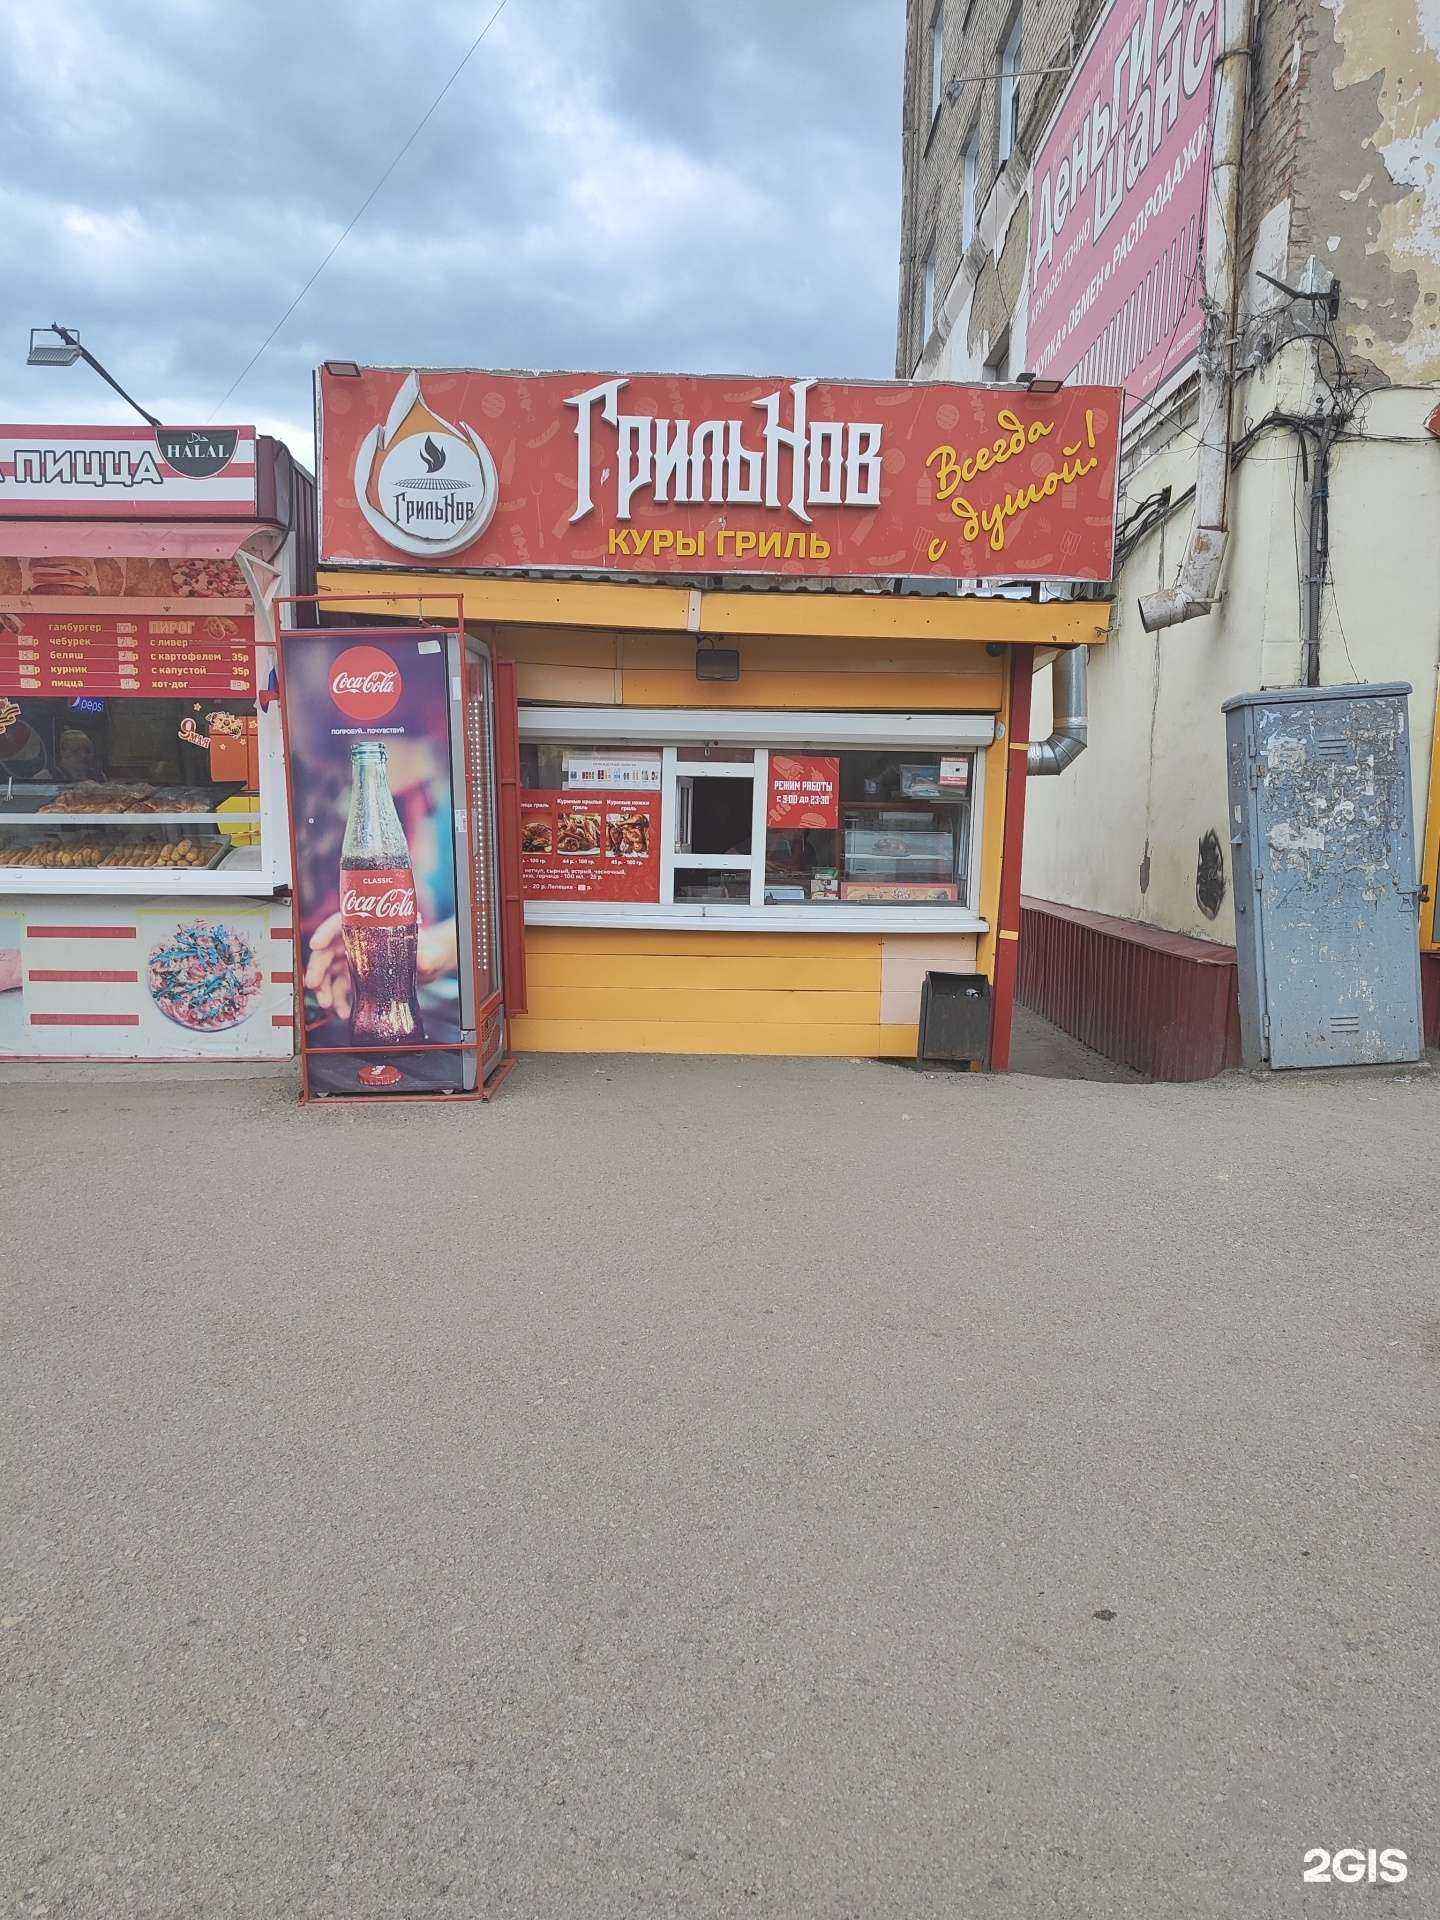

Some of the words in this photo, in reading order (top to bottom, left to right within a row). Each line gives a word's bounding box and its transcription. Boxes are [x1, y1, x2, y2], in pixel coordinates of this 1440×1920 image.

[1068, 266, 1106, 335] ОБМЕН
[167, 444, 230, 458] HALAL
[925, 409, 1055, 500] Всегда
[13, 449, 164, 487] ПИЦЦА
[927, 535, 948, 562] с
[951, 409, 1098, 552] душой!
[608, 528, 705, 557] КУРЫ
[716, 529, 832, 560] ГРИЛЬ
[48, 622, 102, 633] гамбургер
[148, 620, 196, 634] ПИРОГ
[49, 637, 92, 647] чебурек
[50, 650, 84, 660] беляш
[158, 652, 222, 662] картофелем
[231, 652, 249, 662] 35р
[50, 665, 88, 675] курник
[159, 665, 207, 676] капустой
[232, 666, 250, 677] 35р
[51, 679, 84, 690] пицца
[151, 680, 189, 690] хот-дог
[332, 671, 395, 694] Coca-Cola
[81, 699, 104, 712] pepsi
[774, 780, 801, 791] РЕЖИМ
[802, 781, 833, 792] РАБОТЫ
[799, 796, 809, 805] до
[362, 876, 394, 885] CLASSIC
[341, 887, 415, 920] Coca-Cola
